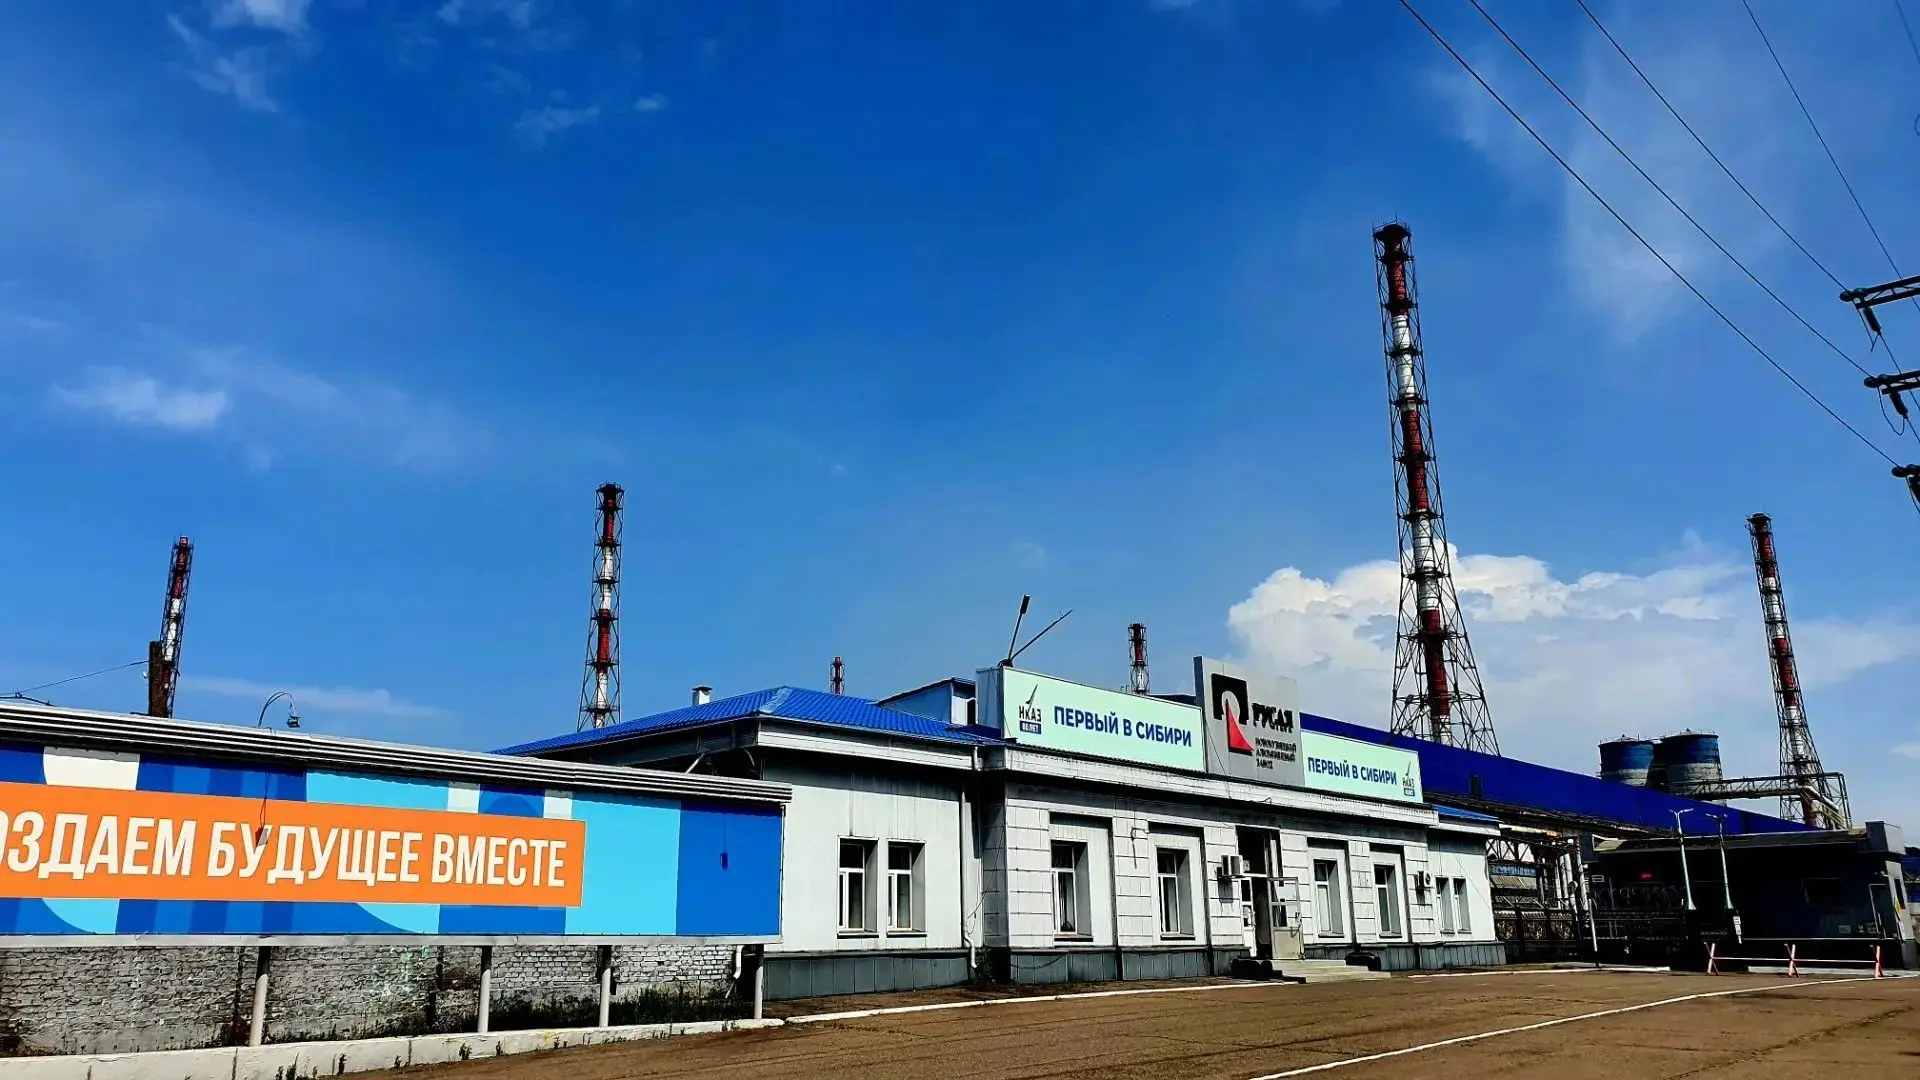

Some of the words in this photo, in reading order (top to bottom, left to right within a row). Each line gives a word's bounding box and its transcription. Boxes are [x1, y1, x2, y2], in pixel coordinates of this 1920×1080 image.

[1019, 705, 1041, 722] НКАЗ
[1054, 705, 1119, 735] ПЕРВЫЙ
[1123, 718, 1132, 736] В
[1136, 721, 1192, 747] СИБИРИ
[1308, 757, 1350, 778] ПЕРВЫЙ
[1352, 764, 1359, 779] В
[1361, 766, 1397, 785] СИБИРИ
[0, 810, 196, 880] ЗДАЕМ
[207, 821, 423, 887] БУДУЩЕЕ
[431, 833, 567, 887] ВМЕСТЕ
